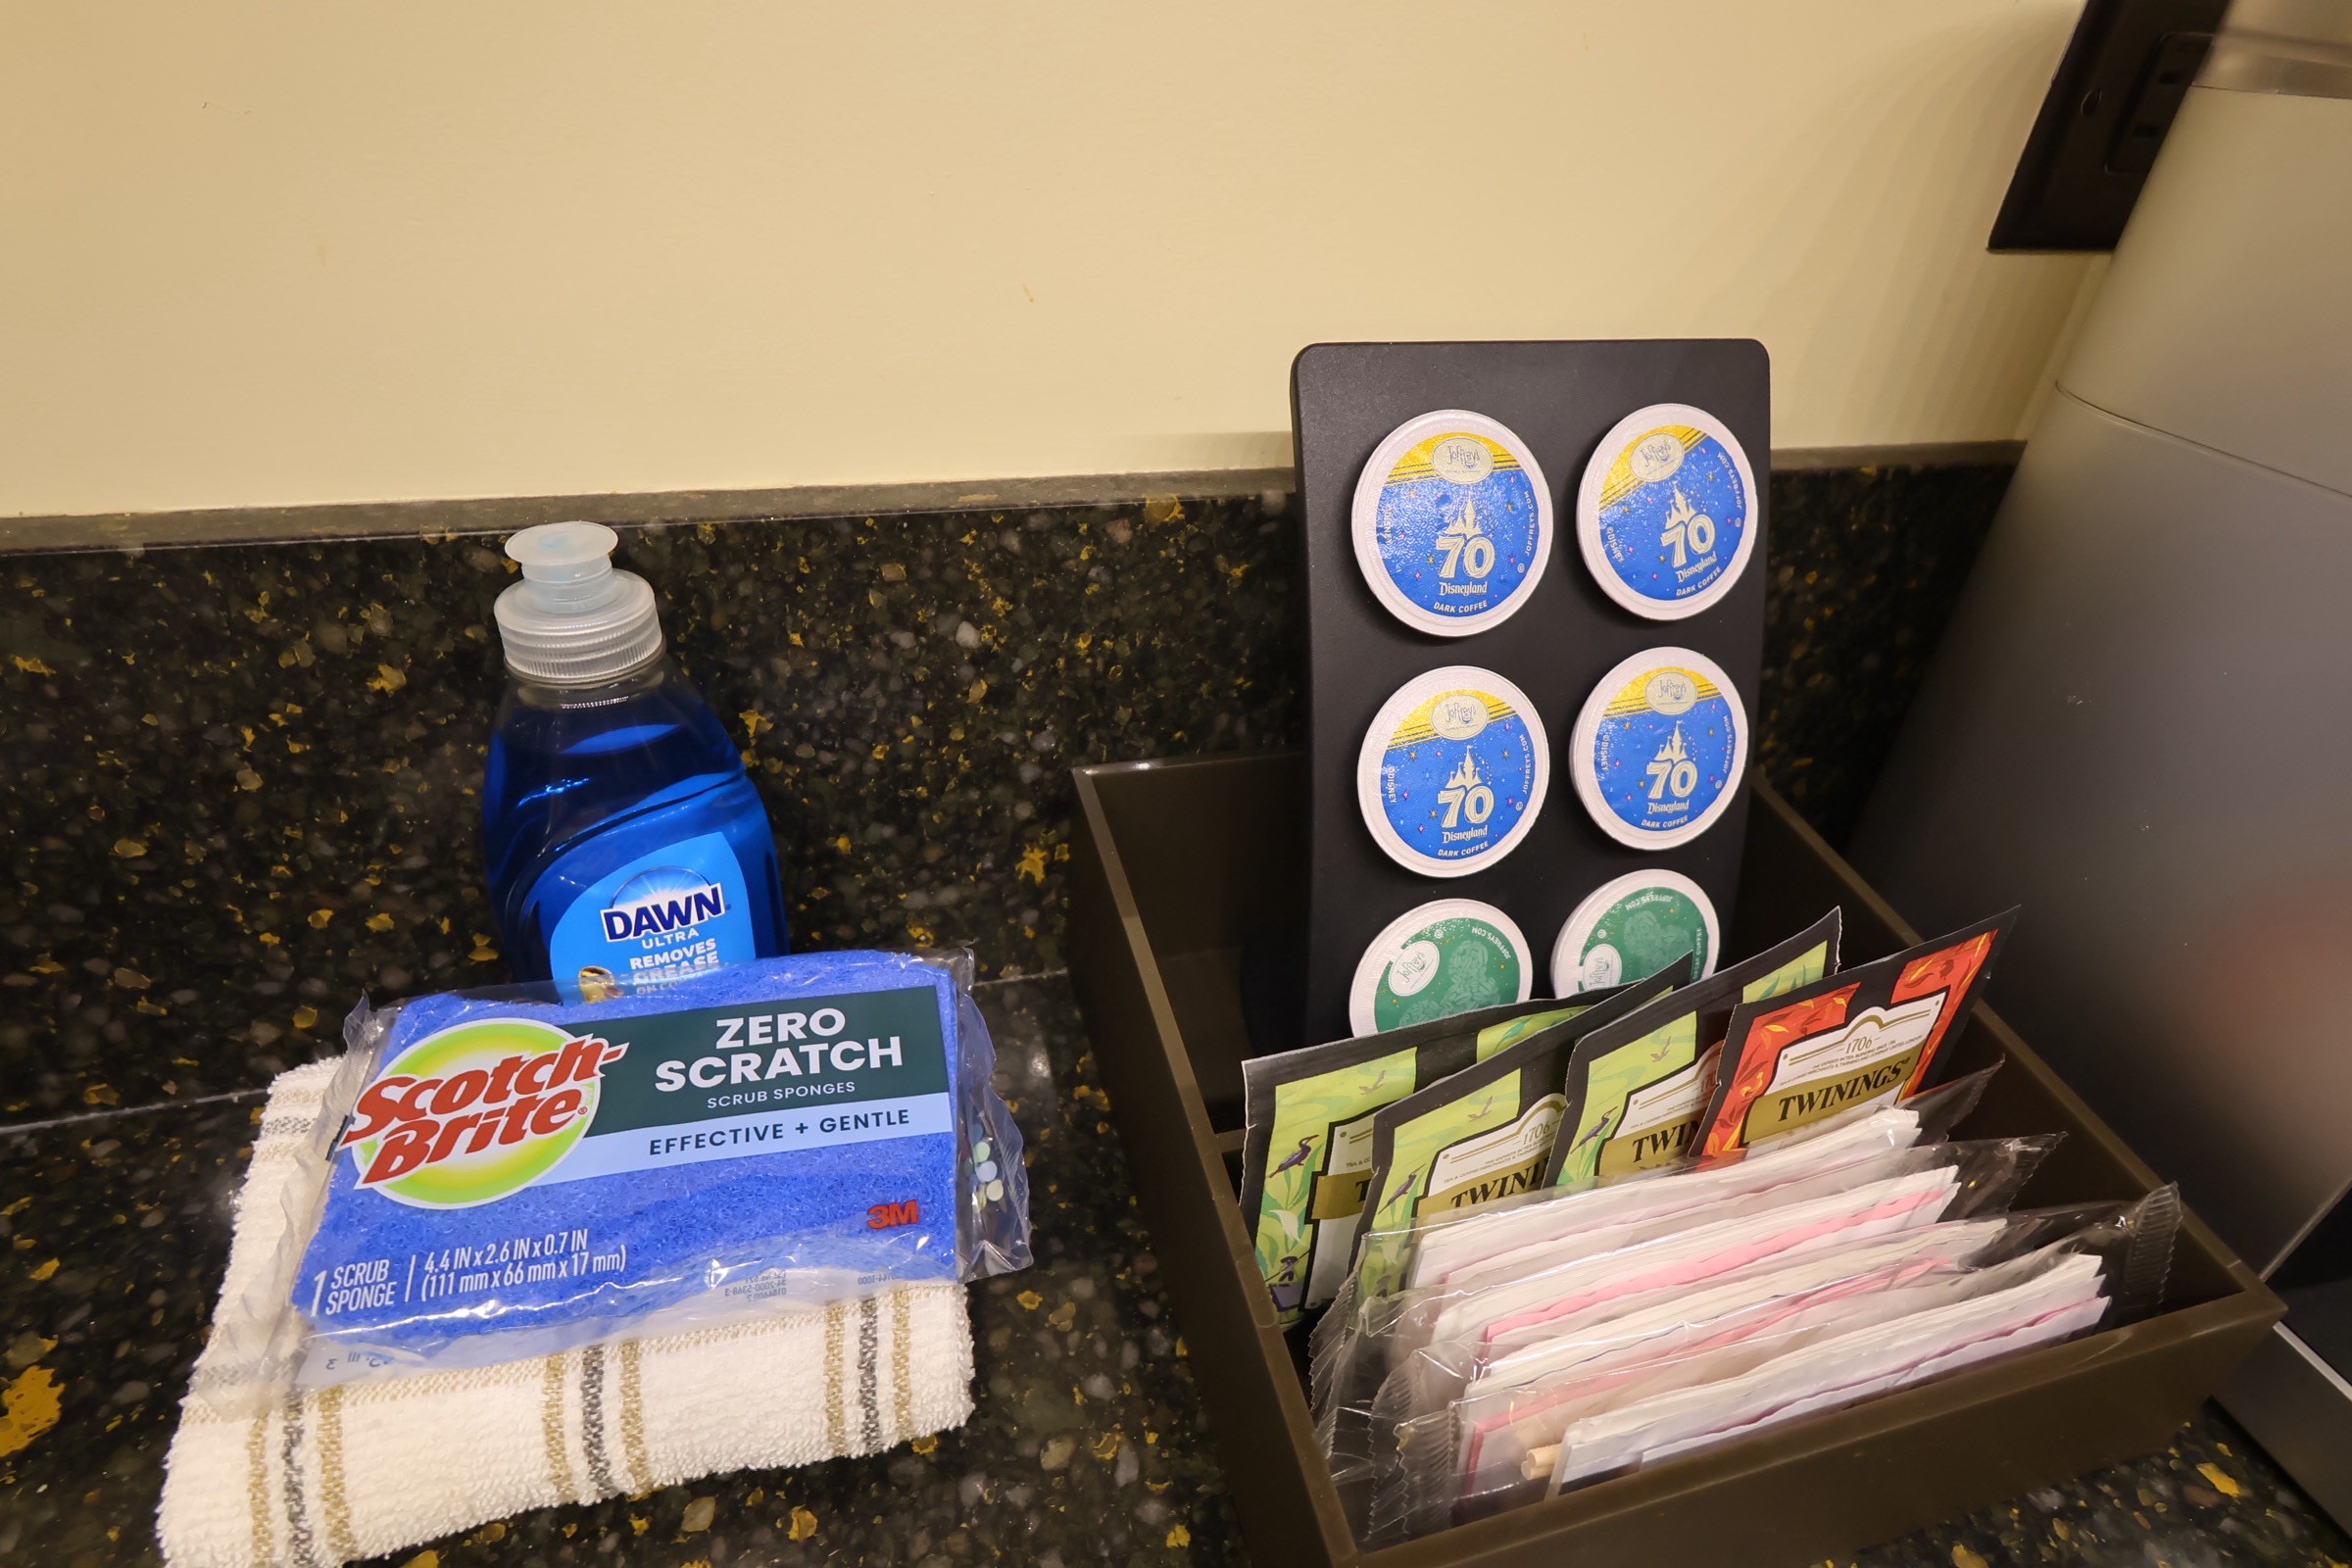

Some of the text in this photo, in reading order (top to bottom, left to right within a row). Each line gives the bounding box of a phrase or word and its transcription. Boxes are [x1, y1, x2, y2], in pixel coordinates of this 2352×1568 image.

[1660, 514, 1715, 568] 70
[1436, 536, 1495, 579] 70
[1676, 552, 1718, 583] Disneyland
[1439, 581, 1488, 597] Disneyland
[1676, 565, 1722, 597] DARK COFFEE
[1433, 600, 1488, 613] DARK COFFEE
[1646, 760, 1698, 800] 70
[1438, 785, 1494, 828] 70
[1642, 814, 1689, 828] DARK COFFEE
[1647, 799, 1690, 814] Disneyland
[1438, 841, 1490, 857] DARK COFFEE
[1442, 825, 1489, 844] Disneyland
[603, 887, 721, 941] DAWN
[630, 939, 716, 969] REMOVES
[642, 929, 699, 950] ULTRA
[633, 950, 720, 983] GREASE
[716, 1007, 846, 1050] ZERO
[1845, 1036, 1872, 1054] 1706
[655, 1036, 903, 1092] SCRATCH
[707, 1081, 856, 1108] SCRUB SPONGES
[1778, 1061, 1903, 1122] TWININGS
[650, 1123, 783, 1155] EFFECTIVE
[820, 1109, 909, 1133] GENTLE
[1523, 1122, 1549, 1146] 1706
[867, 1200, 918, 1229] 3M
[424, 1228, 588, 1273] 4.4 IN x 2.6 IN x 0.7 IN
[331, 1258, 390, 1290] SCRUB
[421, 1244, 627, 1301] (111 mm x 66 mm x 17 mm)
[311, 1270, 327, 1317] 1
[325, 1281, 397, 1315] SPONGE
